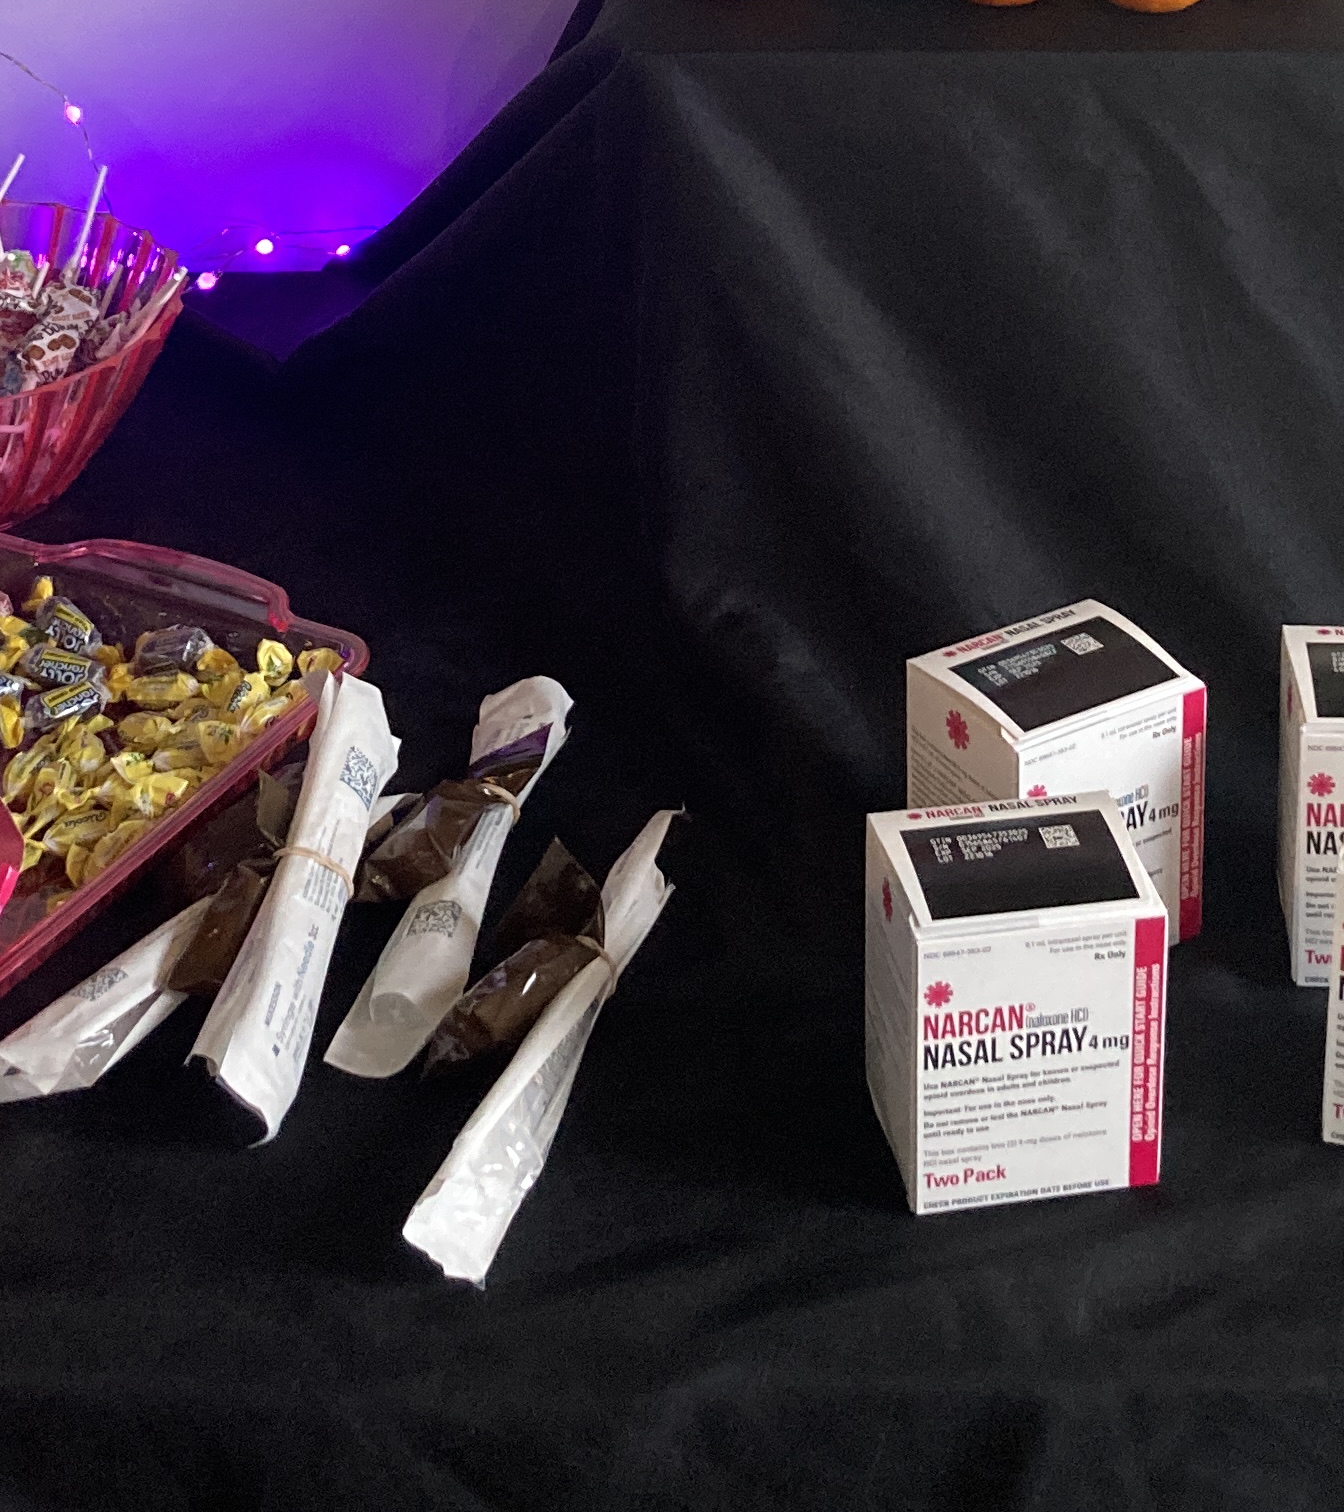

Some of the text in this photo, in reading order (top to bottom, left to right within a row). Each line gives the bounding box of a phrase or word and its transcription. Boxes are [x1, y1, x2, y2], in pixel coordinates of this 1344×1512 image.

[40, 668, 85, 685] JOLLY
[986, 800, 1032, 812] NASAL
[1033, 795, 1079, 807] SPRAY
[1159, 803, 1179, 820] mg
[1094, 949, 1125, 960] Rx Only
[1306, 949, 1333, 965] Tw
[923, 1025, 1129, 1070] NASAL SPRAY 4 mg
[923, 1162, 1007, 1189] Two Pack
